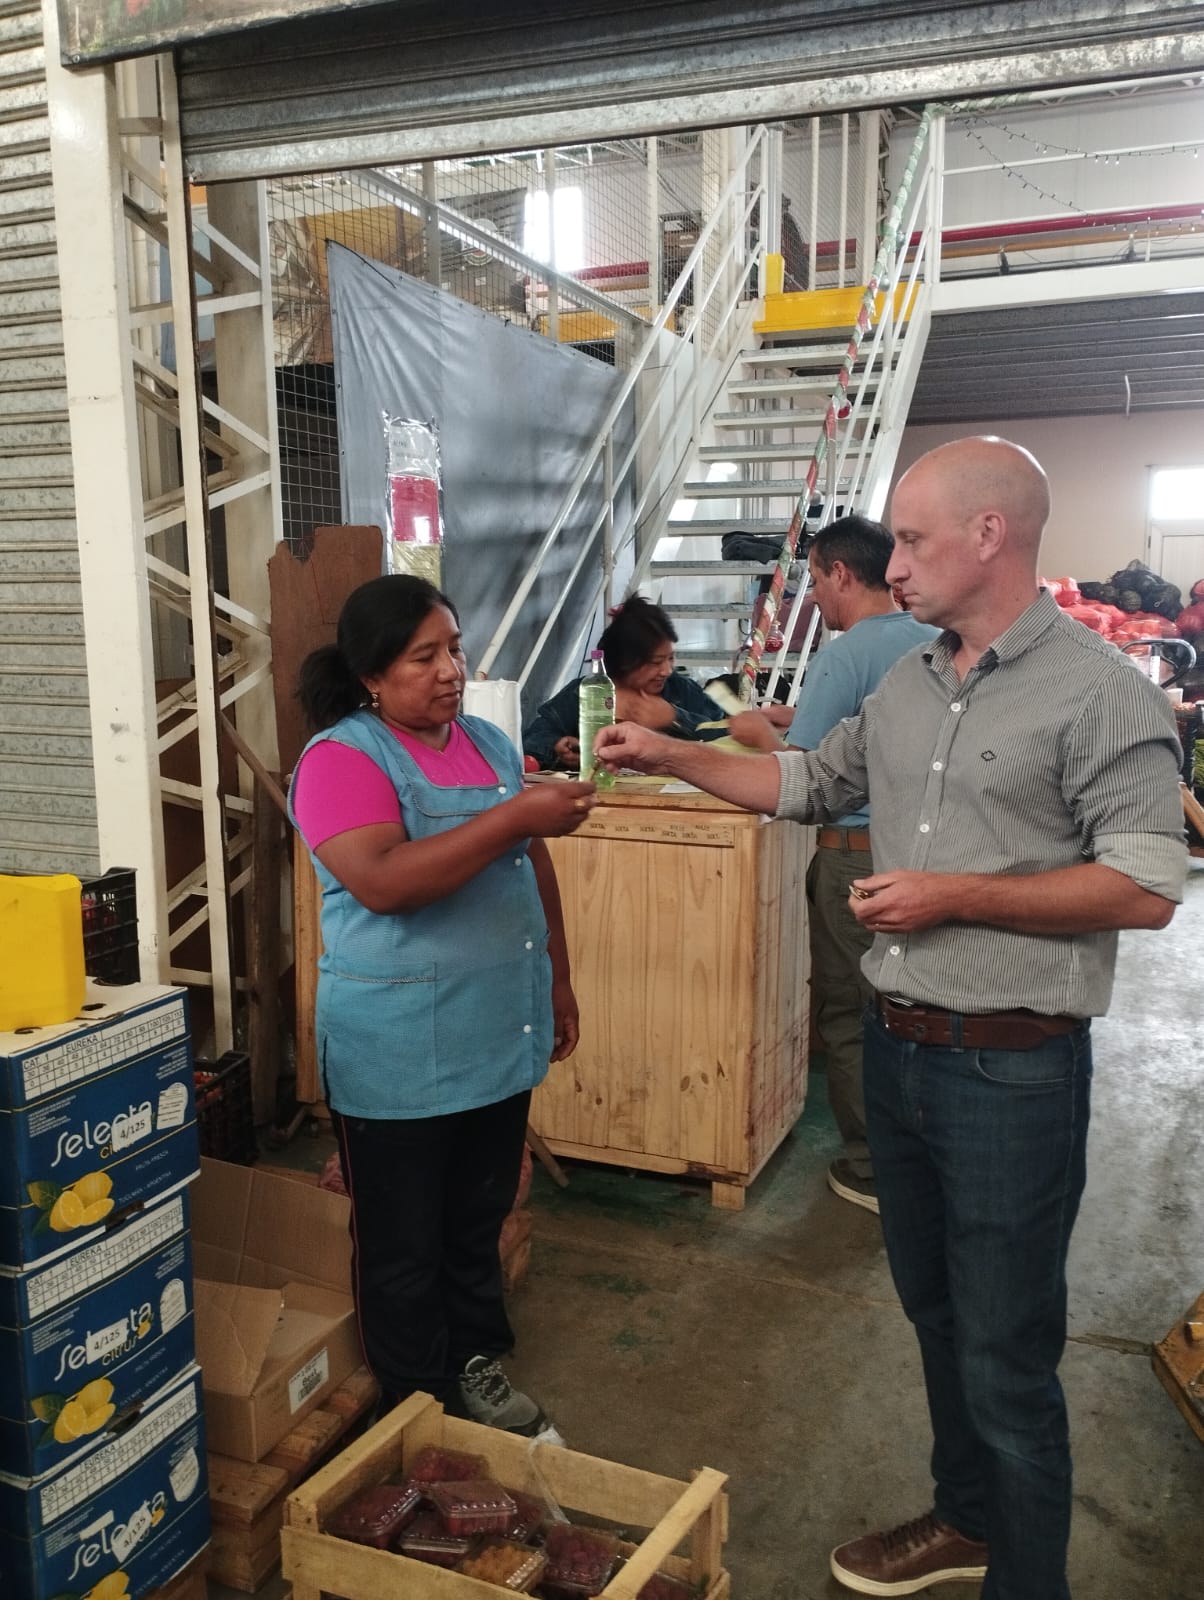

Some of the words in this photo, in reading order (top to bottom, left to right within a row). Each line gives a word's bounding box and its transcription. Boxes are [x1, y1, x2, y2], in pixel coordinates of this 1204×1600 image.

[65, 1034, 99, 1053] EUREKA
[119, 1119, 146, 1140] 4/125
[70, 1244, 102, 1266] EUREKA
[53, 1302, 151, 1382] Seta
[93, 1328, 121, 1351] 4/125
[84, 1444, 116, 1470] EUREKA
[67, 1490, 165, 1582] Selea
